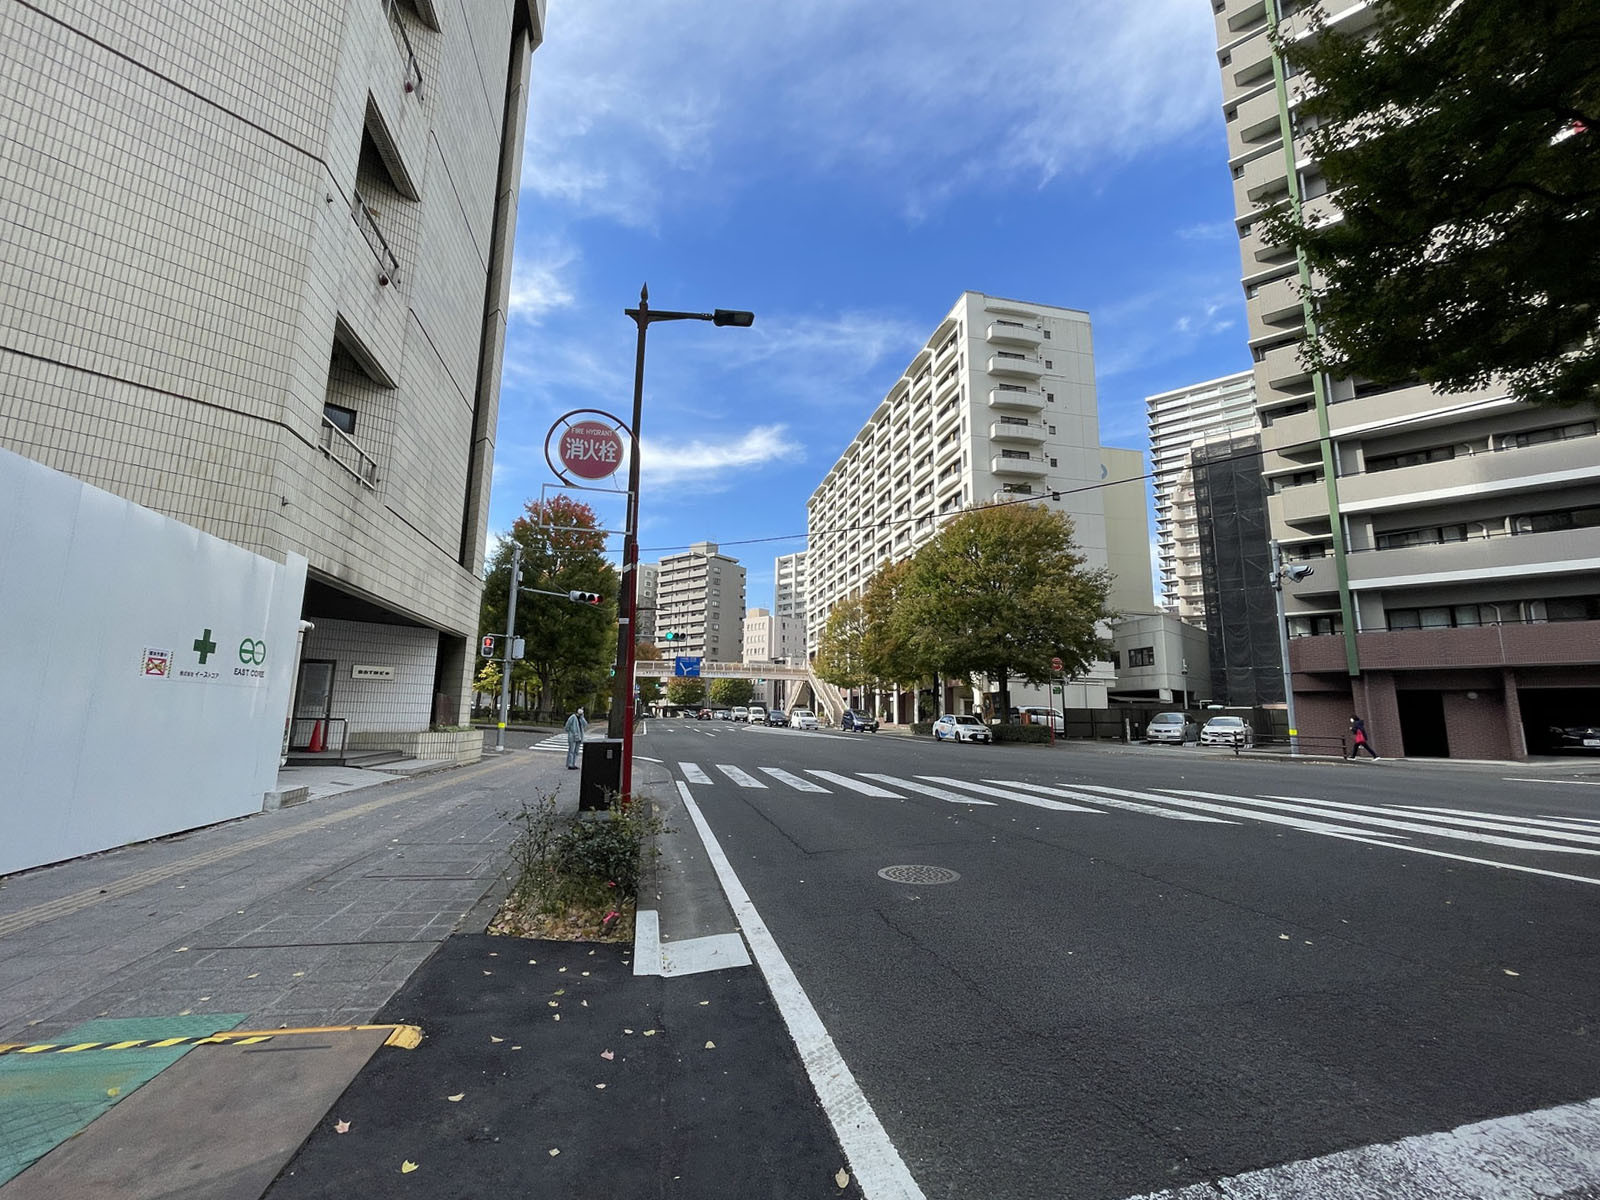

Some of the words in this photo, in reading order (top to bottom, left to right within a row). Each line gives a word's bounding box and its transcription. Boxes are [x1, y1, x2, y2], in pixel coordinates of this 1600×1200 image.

[571, 427, 584, 435] FIRE
[586, 429, 613, 437] HYDRANT
[565, 437, 618, 463] 消火栓
[234, 667, 250, 677] EAST
